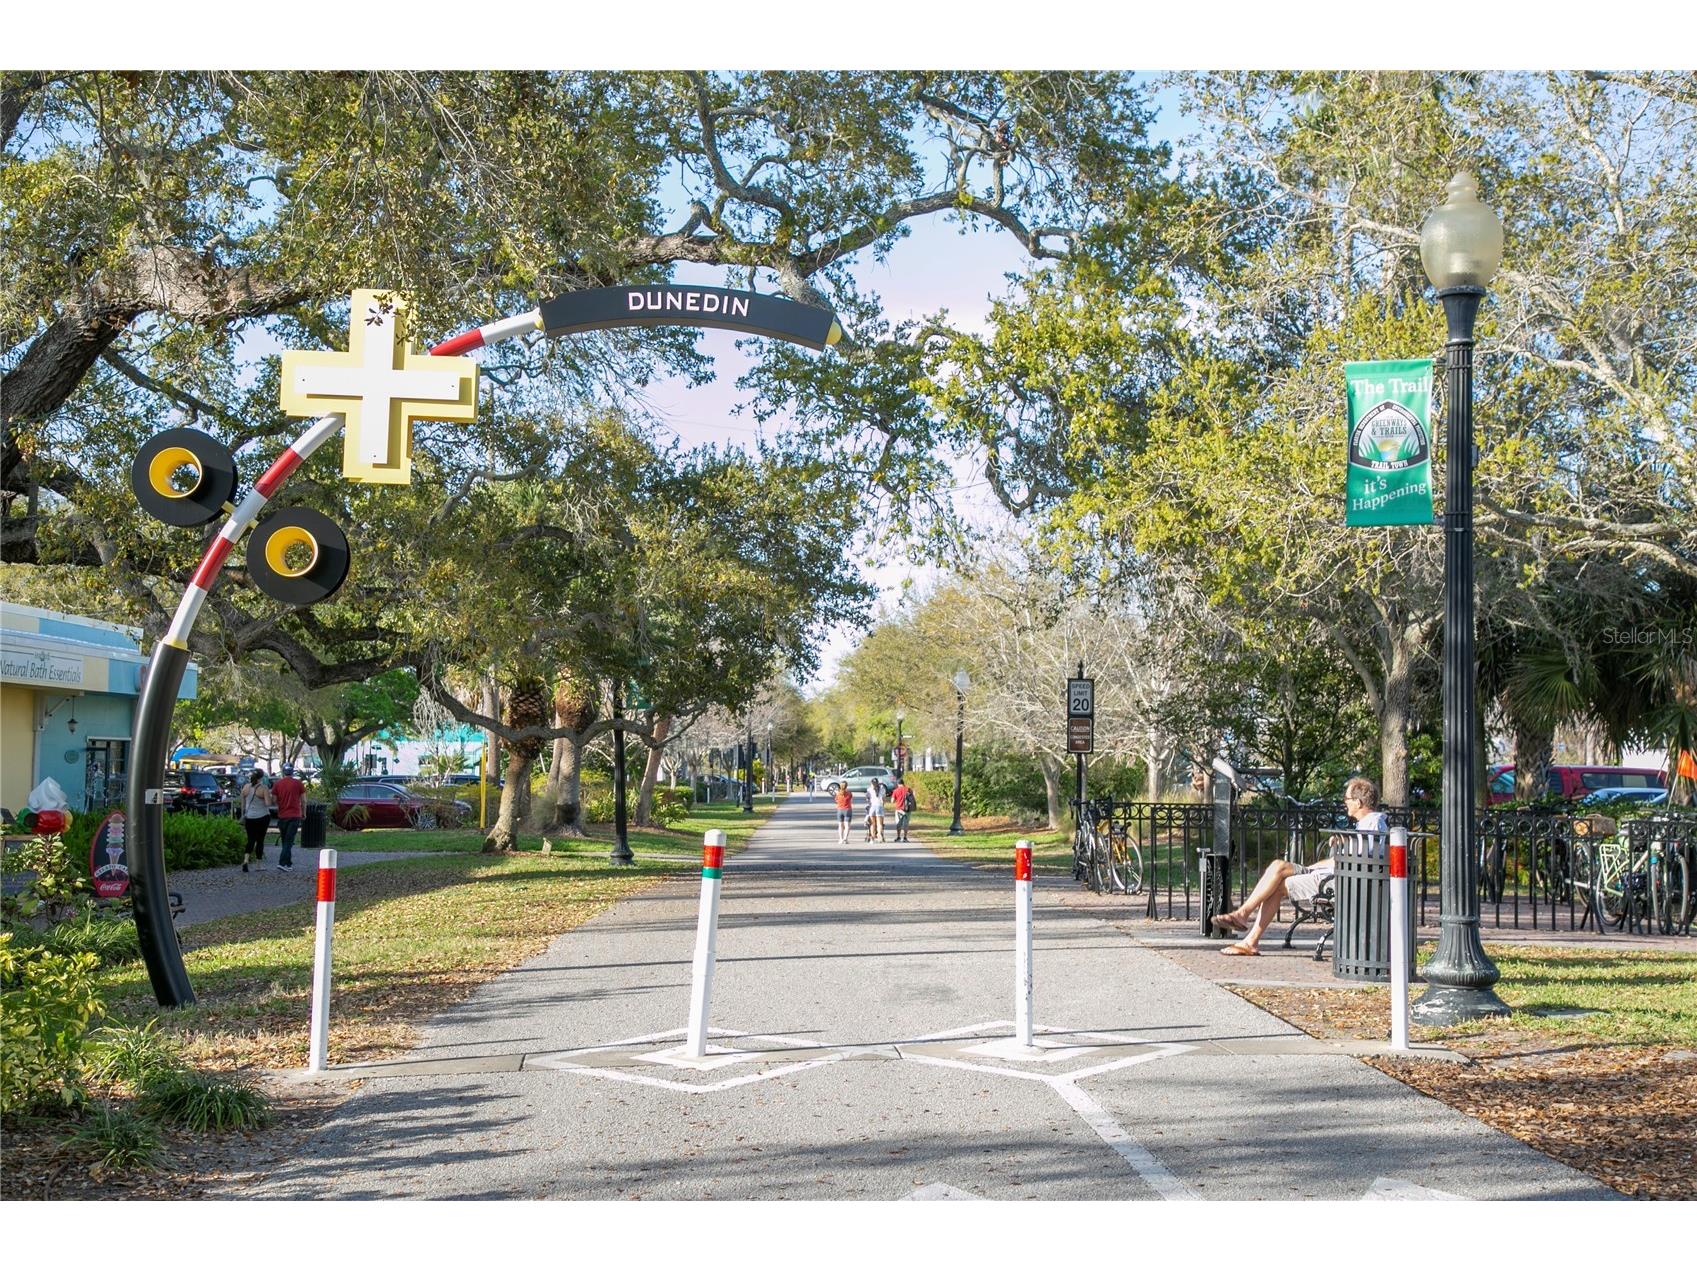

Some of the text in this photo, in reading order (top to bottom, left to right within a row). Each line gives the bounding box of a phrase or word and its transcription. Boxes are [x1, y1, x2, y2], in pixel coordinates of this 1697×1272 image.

[627, 291, 749, 317] DUNEDIN
[1351, 376, 1428, 394] The Trail
[1371, 419, 1407, 427] GREENWAYS
[1380, 427, 1407, 435] TRAILS
[1371, 460, 1408, 469] TRAIL TOWN
[1364, 476, 1387, 494] it's
[1352, 483, 1427, 510] Happening
[0, 659, 81, 682] Natural Bath Essentials
[1072, 698, 1090, 711] 20
